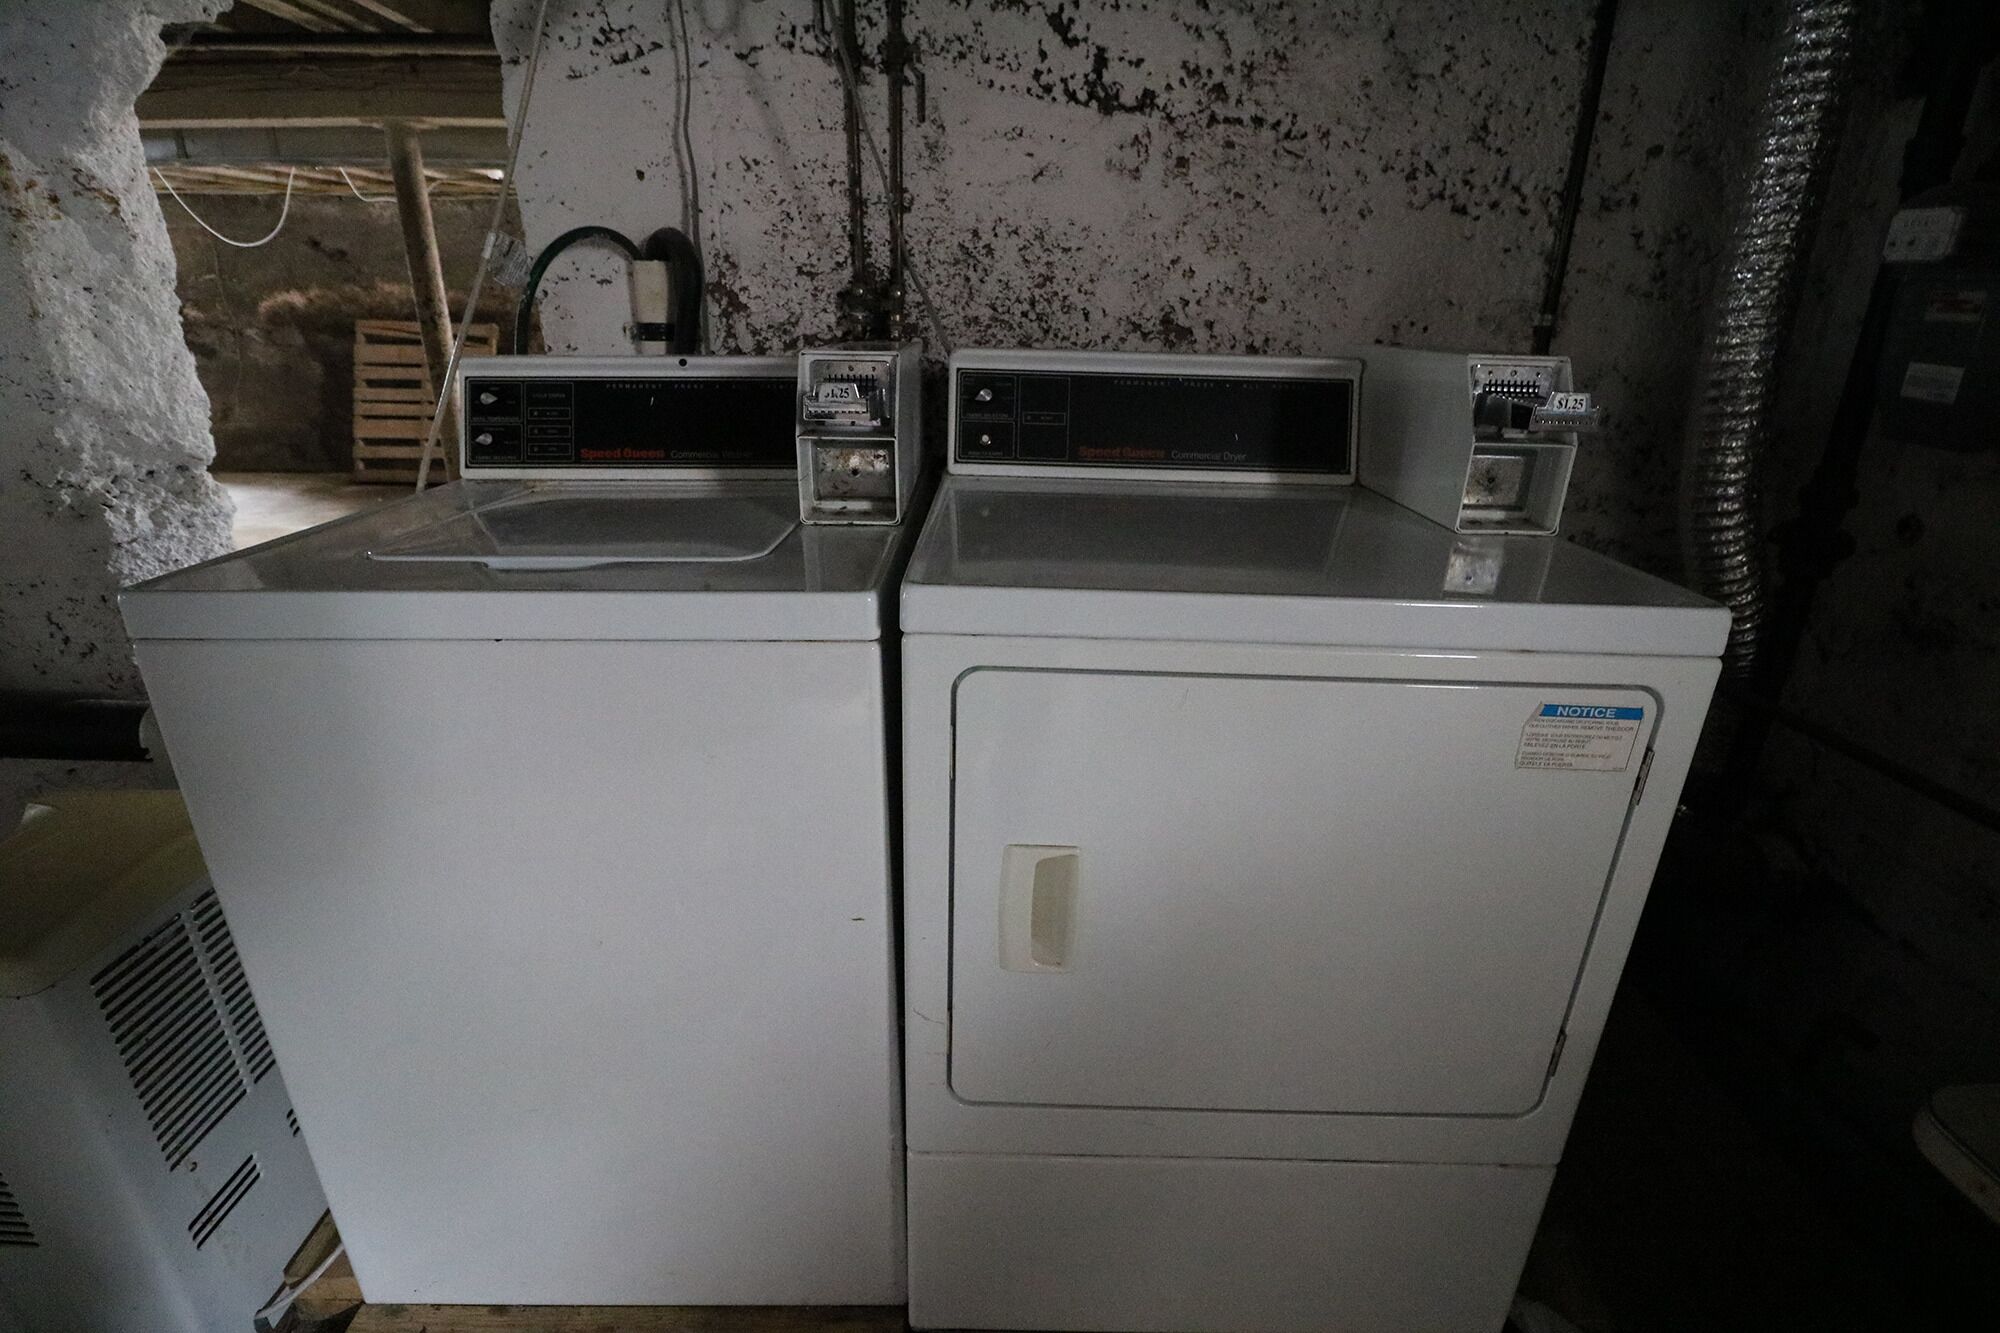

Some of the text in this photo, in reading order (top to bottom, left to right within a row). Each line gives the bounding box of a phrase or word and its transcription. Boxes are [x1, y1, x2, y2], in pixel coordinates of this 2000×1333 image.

[1556, 398, 1585, 410] $1.25
[579, 448, 622, 460] Speed
[623, 447, 666, 460] Queen
[1171, 449, 1222, 462] Commercial
[1223, 451, 1248, 464] Dryer
[1557, 706, 1617, 718] NOTICE
